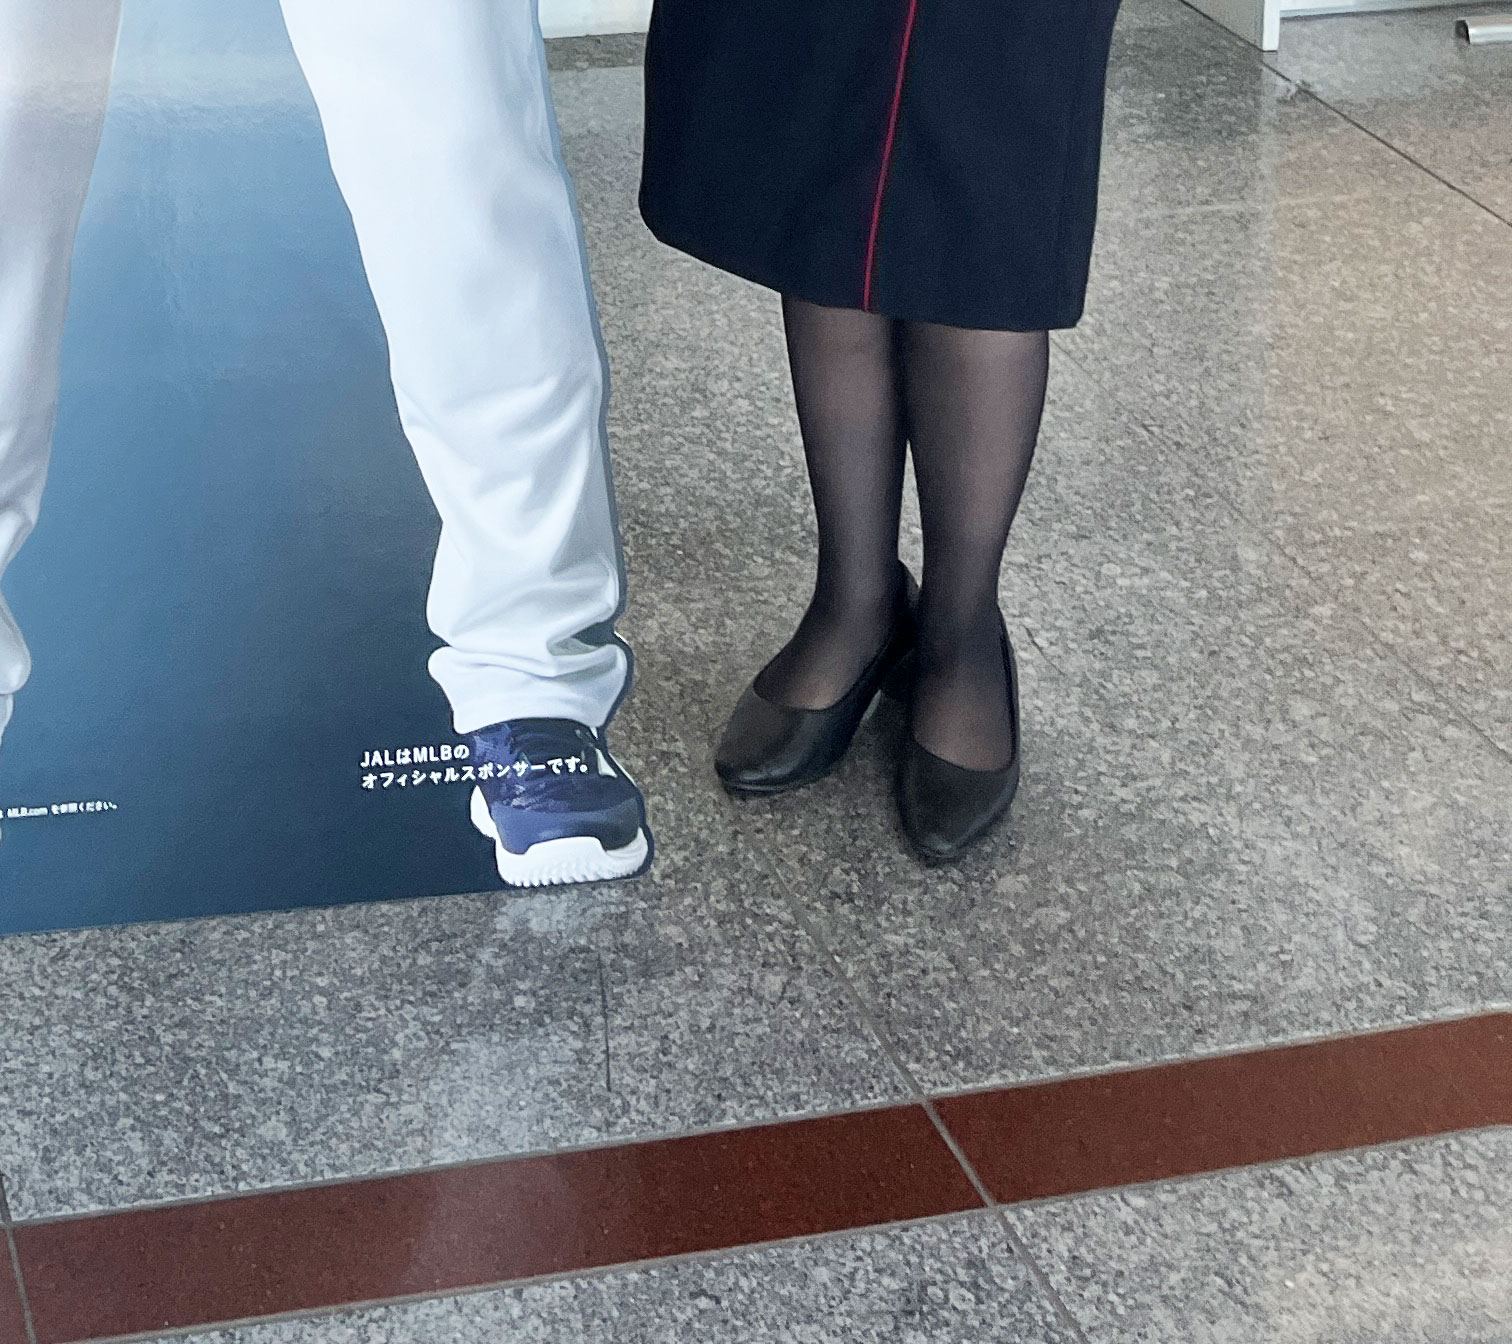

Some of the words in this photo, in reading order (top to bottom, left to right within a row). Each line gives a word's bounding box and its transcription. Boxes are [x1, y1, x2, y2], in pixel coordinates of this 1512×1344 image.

[360, 744, 470, 768] JALはMLBの
[361, 755, 589, 789] オフィシャルスポンサーです。
